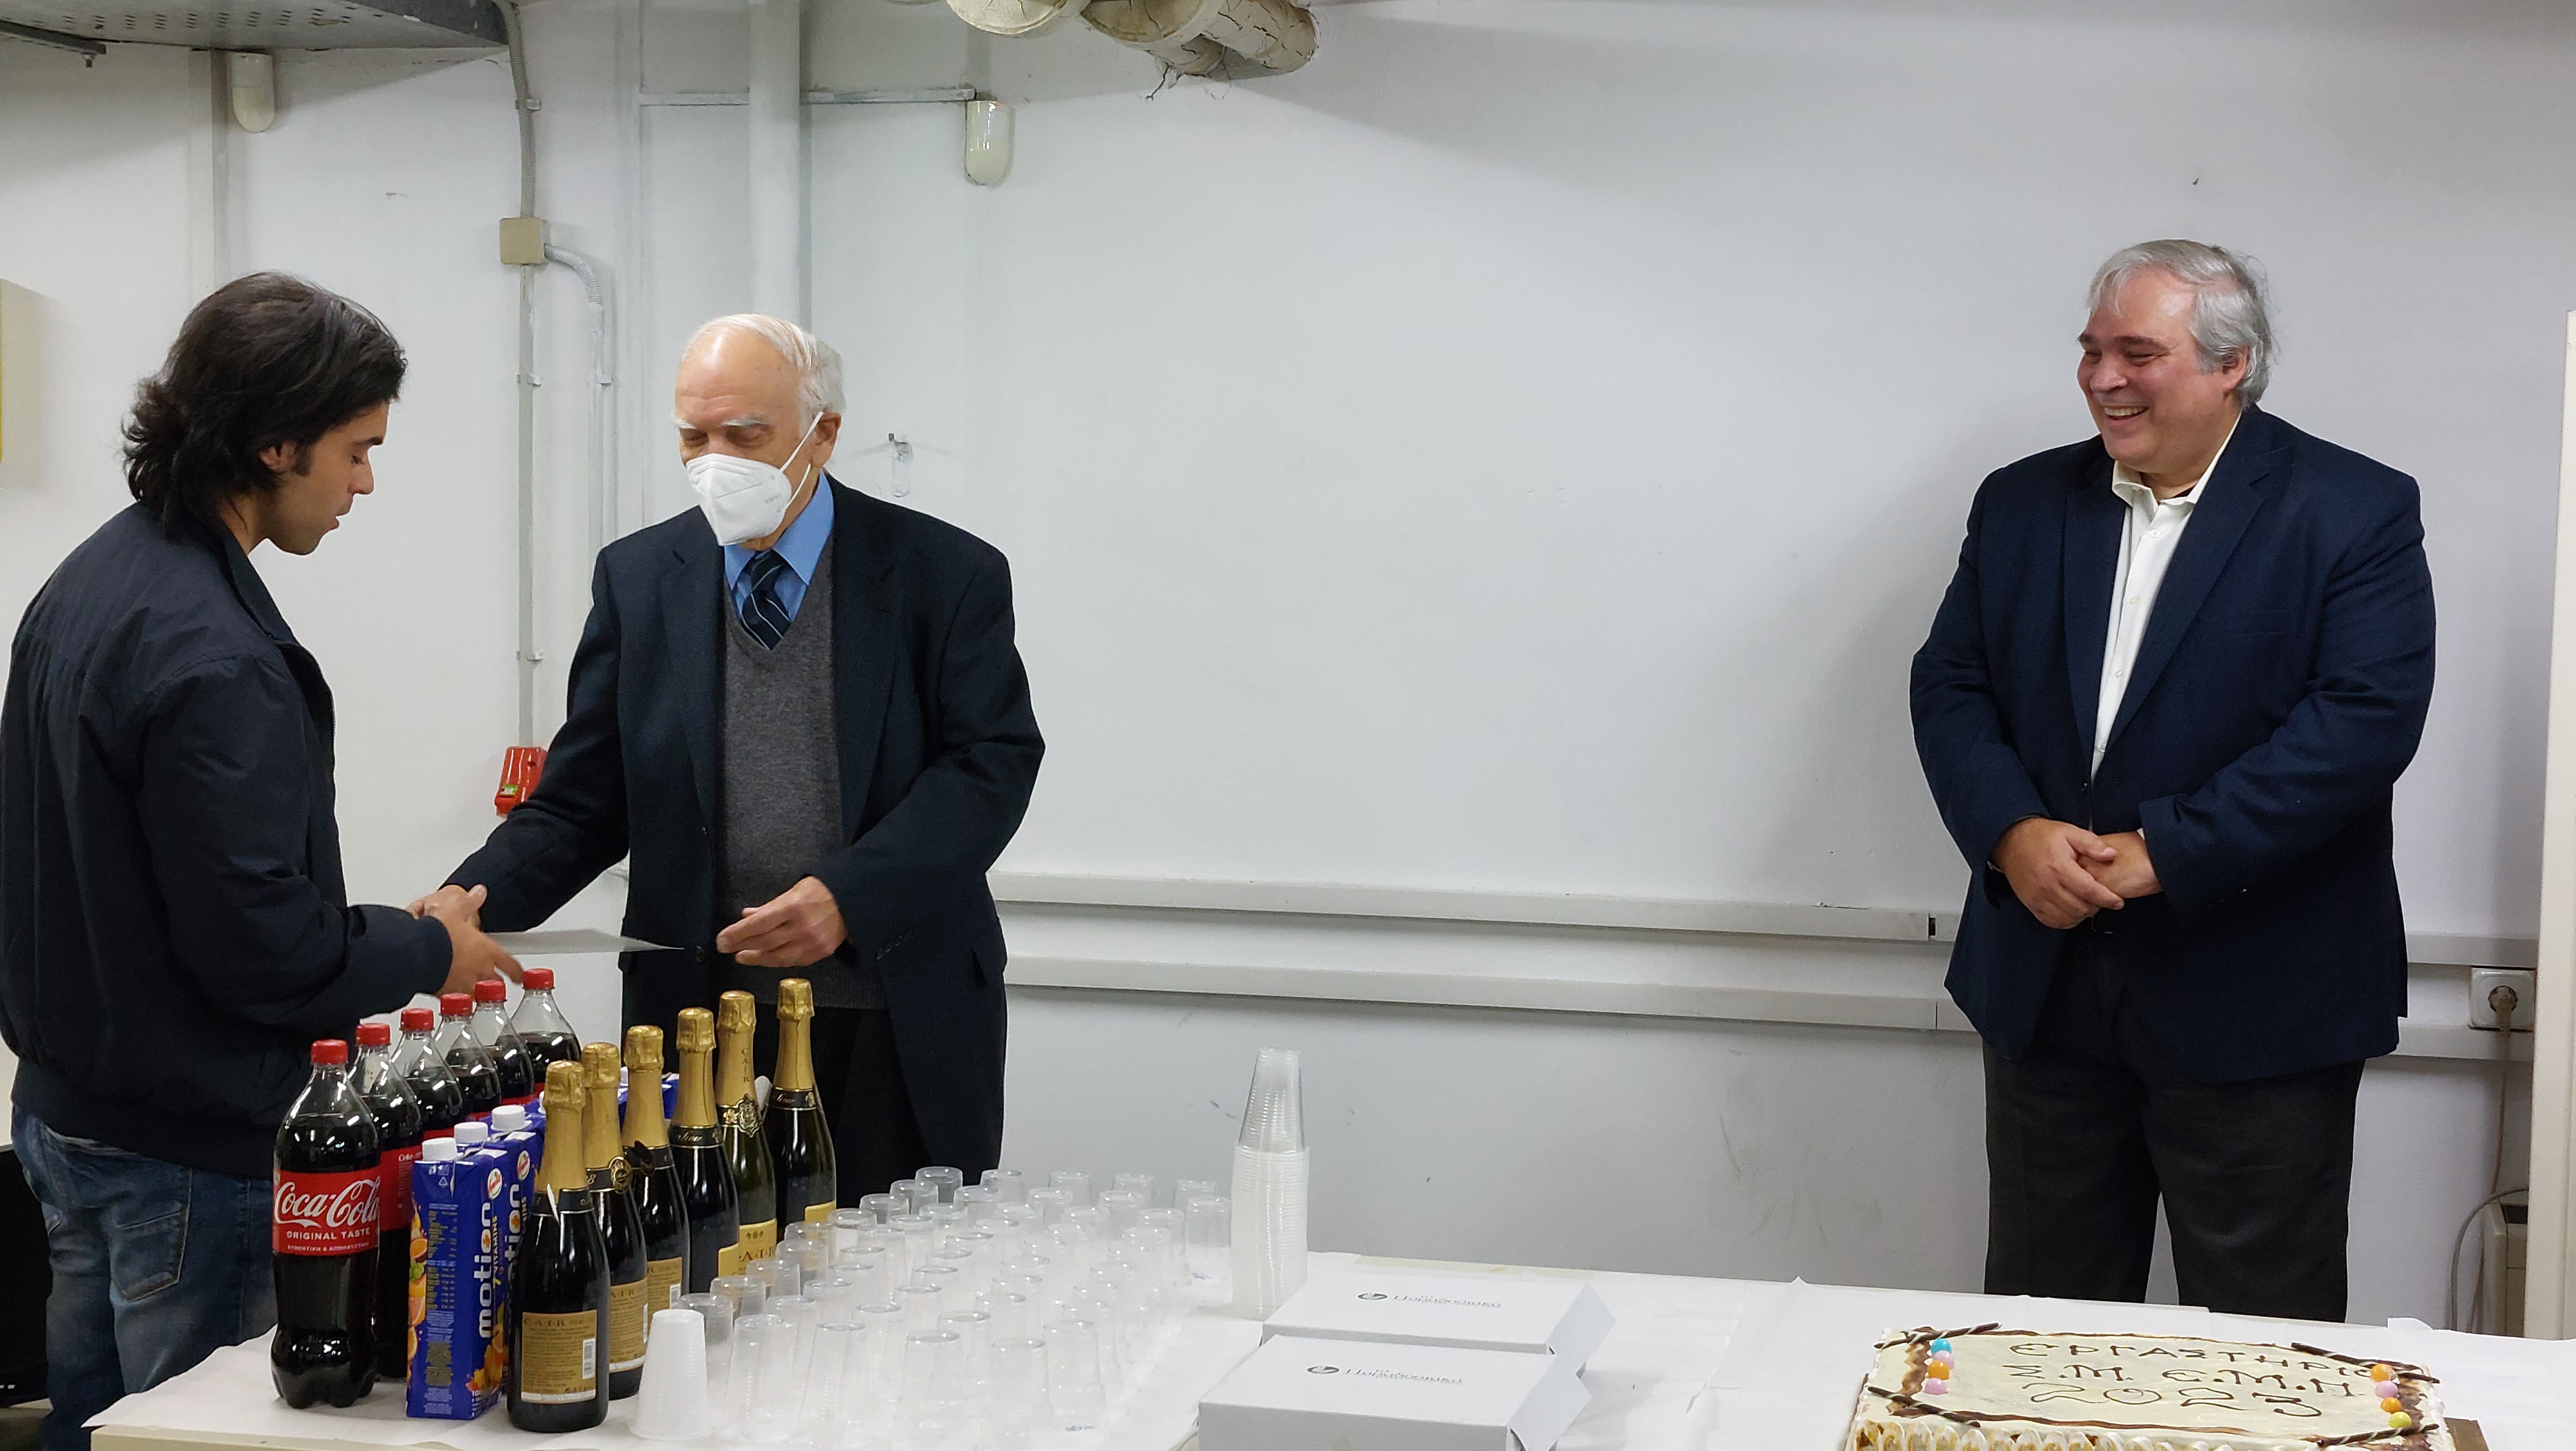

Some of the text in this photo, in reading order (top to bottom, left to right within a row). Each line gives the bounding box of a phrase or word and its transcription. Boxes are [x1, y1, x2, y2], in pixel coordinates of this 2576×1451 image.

[274, 1175, 382, 1229] Coca-Cola
[286, 1227, 370, 1240] ORIGINAL TASTE
[474, 1202, 492, 1338] motion
[2021, 1382, 2322, 1417] 2023
